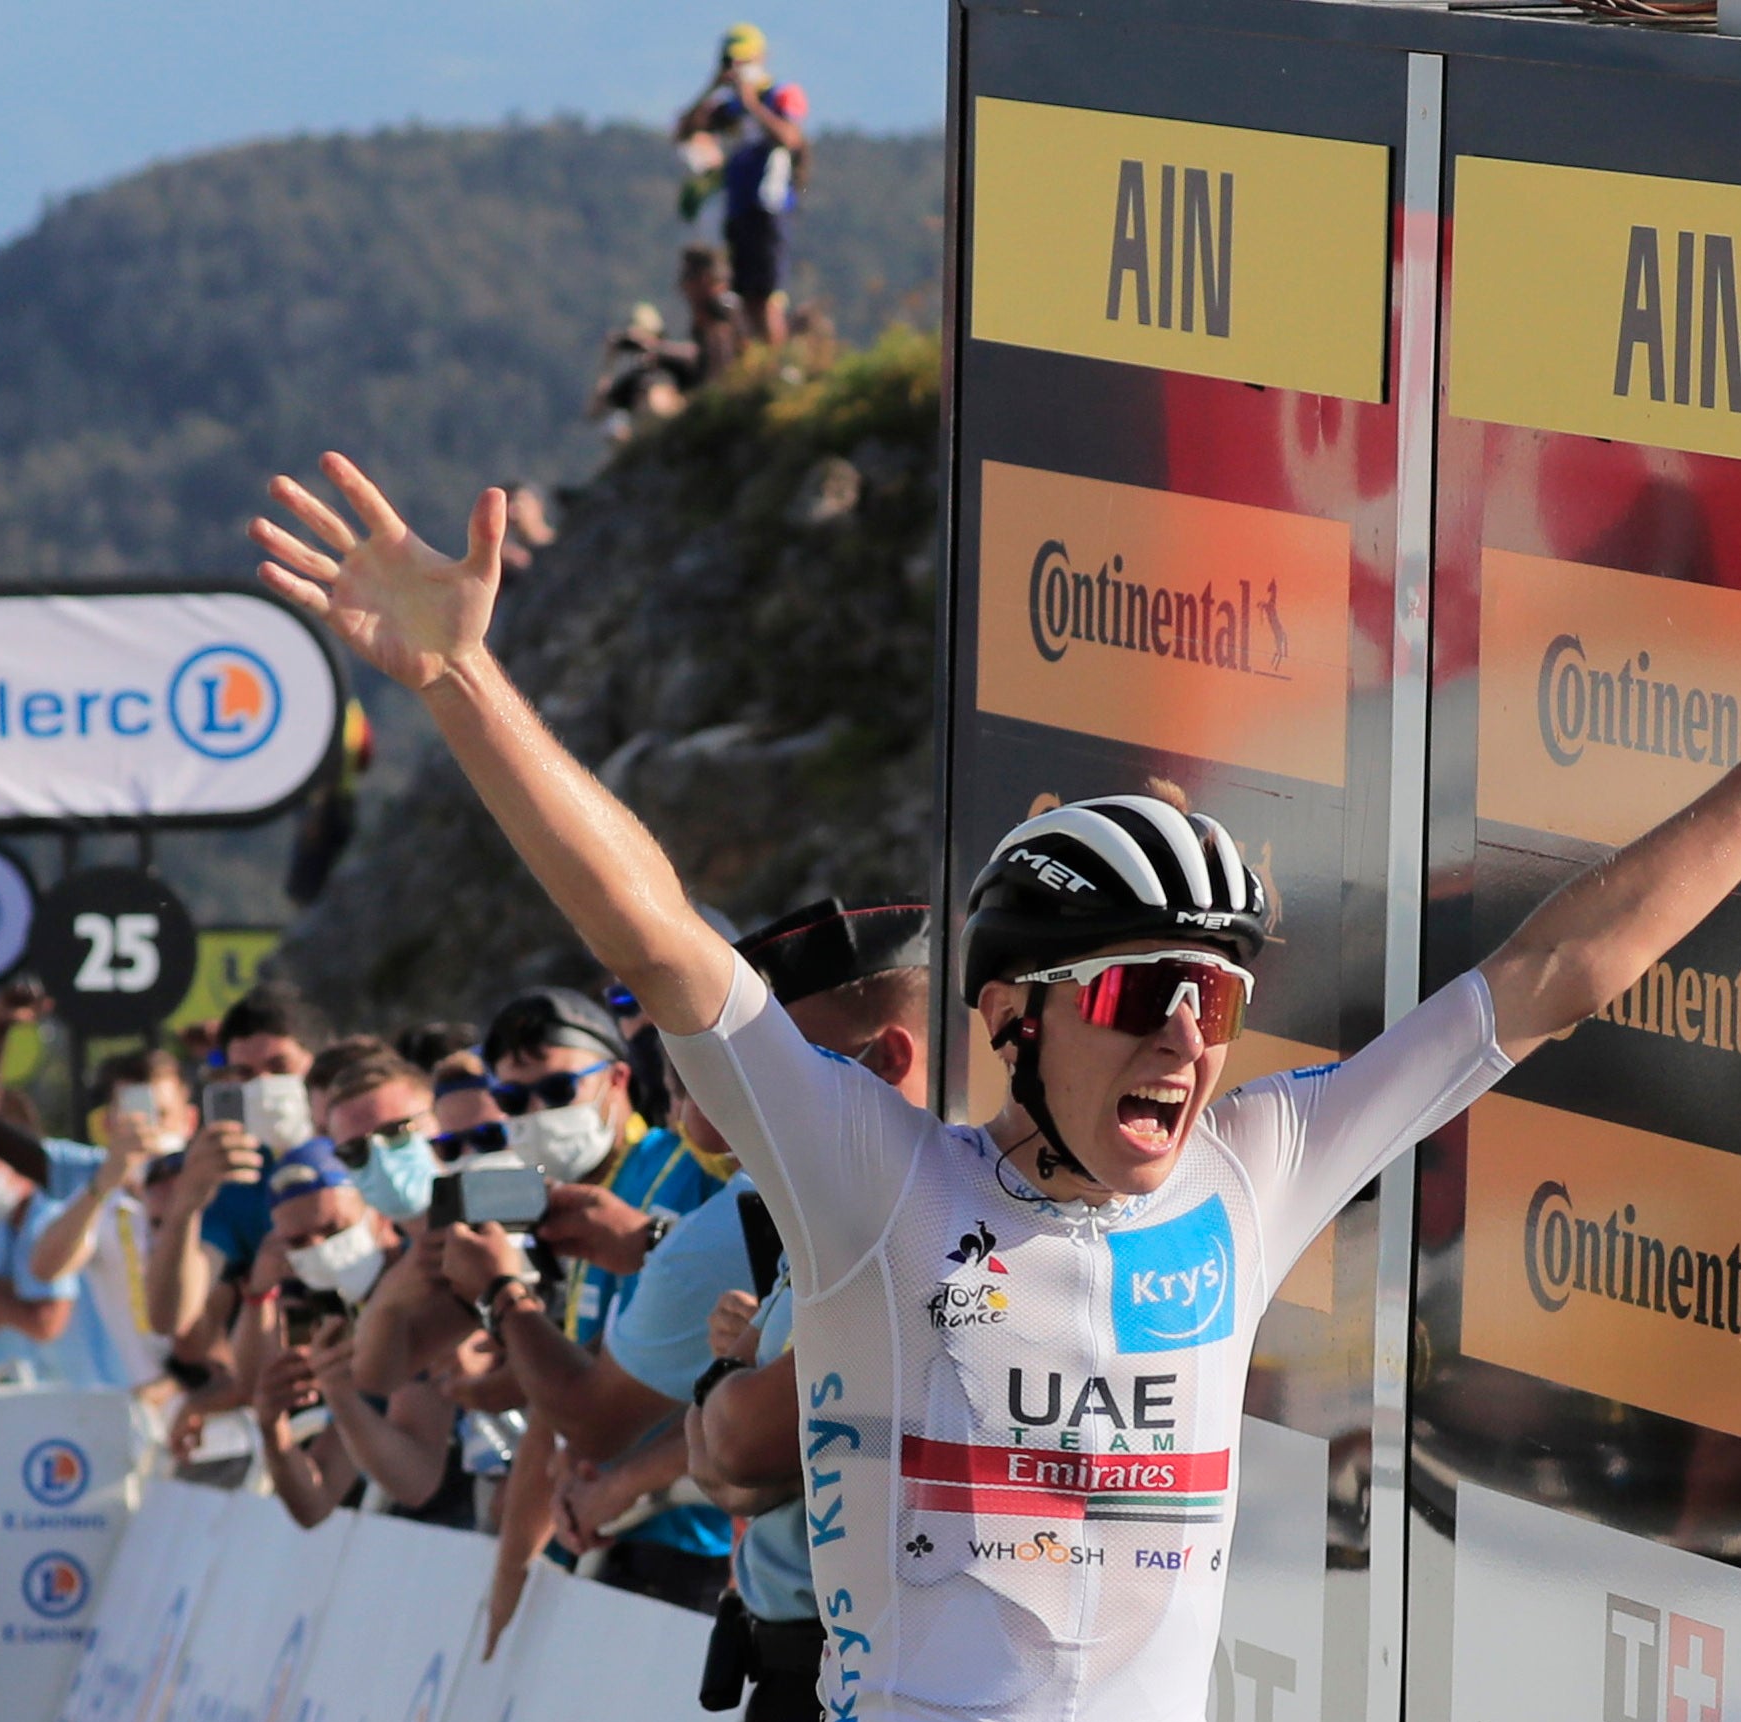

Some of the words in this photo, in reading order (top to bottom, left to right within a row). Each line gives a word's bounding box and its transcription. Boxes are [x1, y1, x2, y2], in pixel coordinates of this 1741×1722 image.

[1105, 158, 1235, 339] AIN
[1029, 538, 1252, 674] Continental
[1008, 848, 1097, 893] MET
[1175, 911, 1237, 931] MET
[72, 911, 161, 994] 25
[1131, 1256, 1220, 1307] Krys
[1008, 1367, 1178, 1430] UAE
[807, 1371, 861, 1548] Krys
[1009, 1426, 1176, 1452] TEAM
[1006, 1453, 1176, 1490] Emirates
